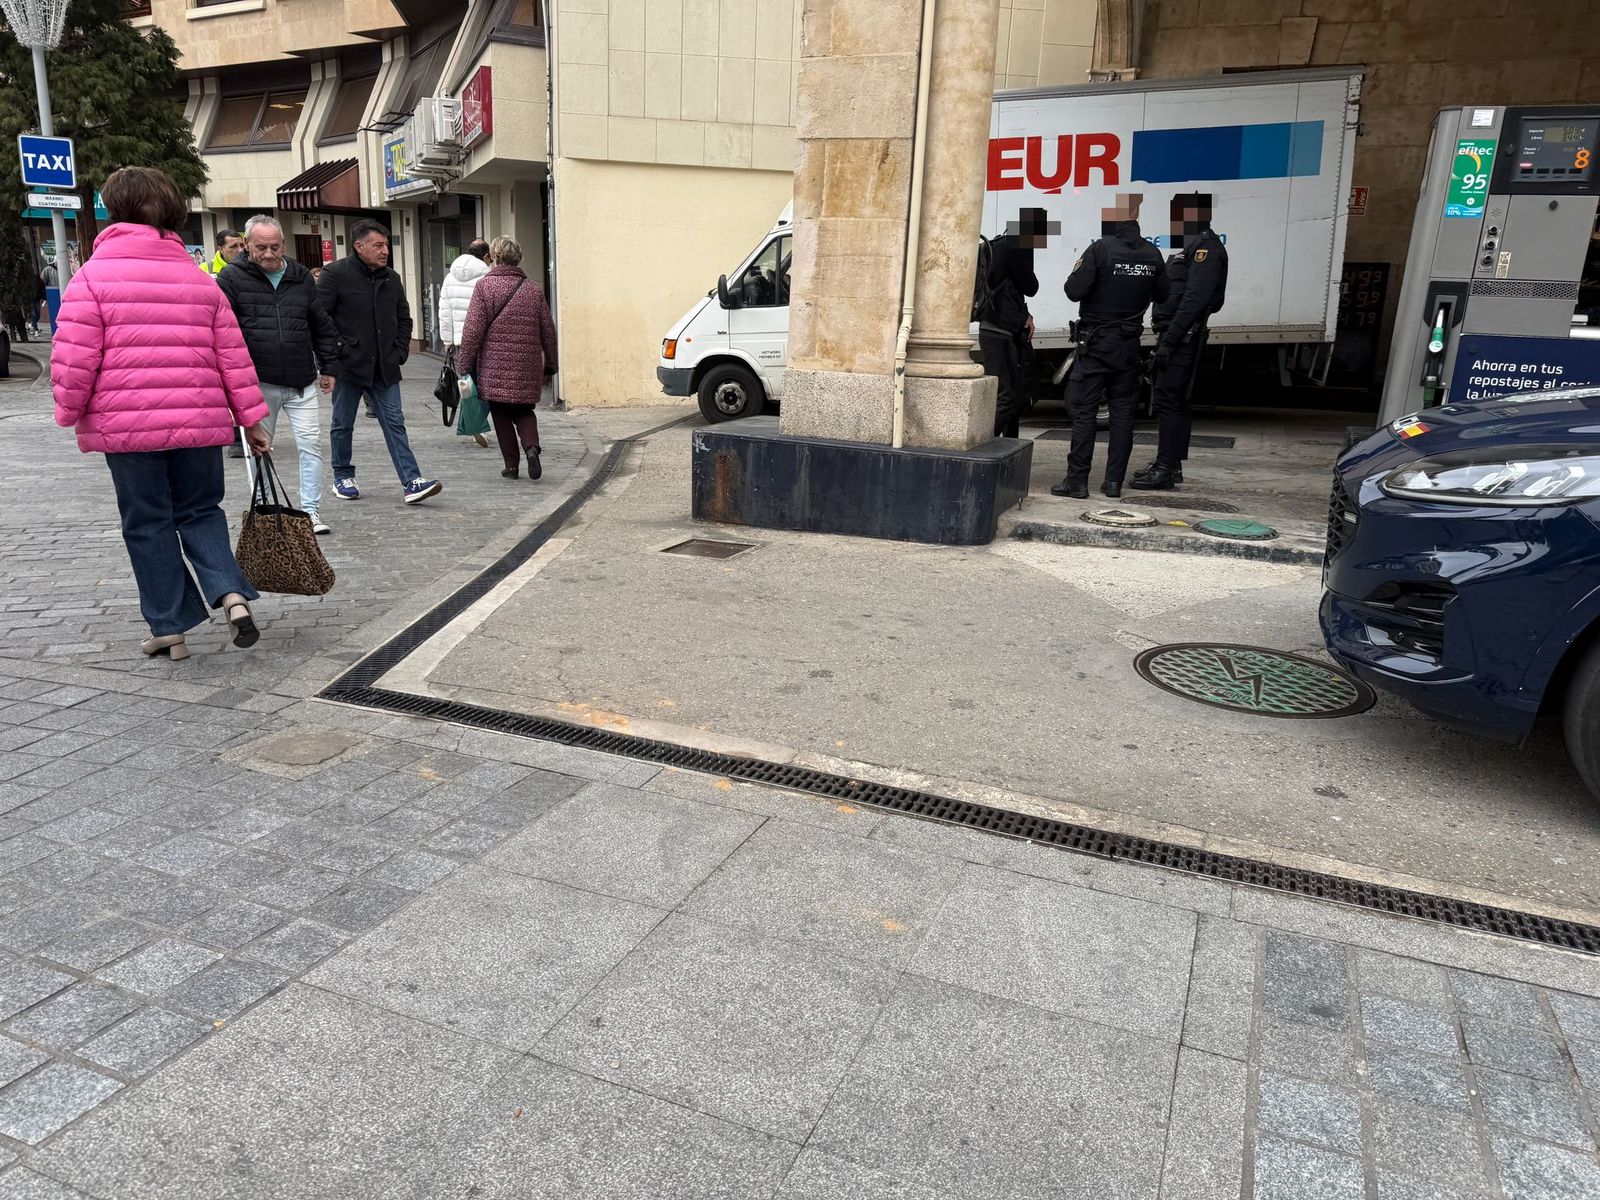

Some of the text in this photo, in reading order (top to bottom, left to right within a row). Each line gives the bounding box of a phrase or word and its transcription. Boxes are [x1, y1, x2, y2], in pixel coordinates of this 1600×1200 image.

[1458, 146, 1494, 156] efitec
[1575, 149, 1590, 168] 8
[23, 153, 72, 171] TAXI
[1461, 174, 1487, 189] 95
[1472, 359, 1564, 375] Ahorra en tus
[1469, 376, 1540, 390] repostajes
[1543, 378, 1557, 390] al
[1466, 388, 1479, 400] la
